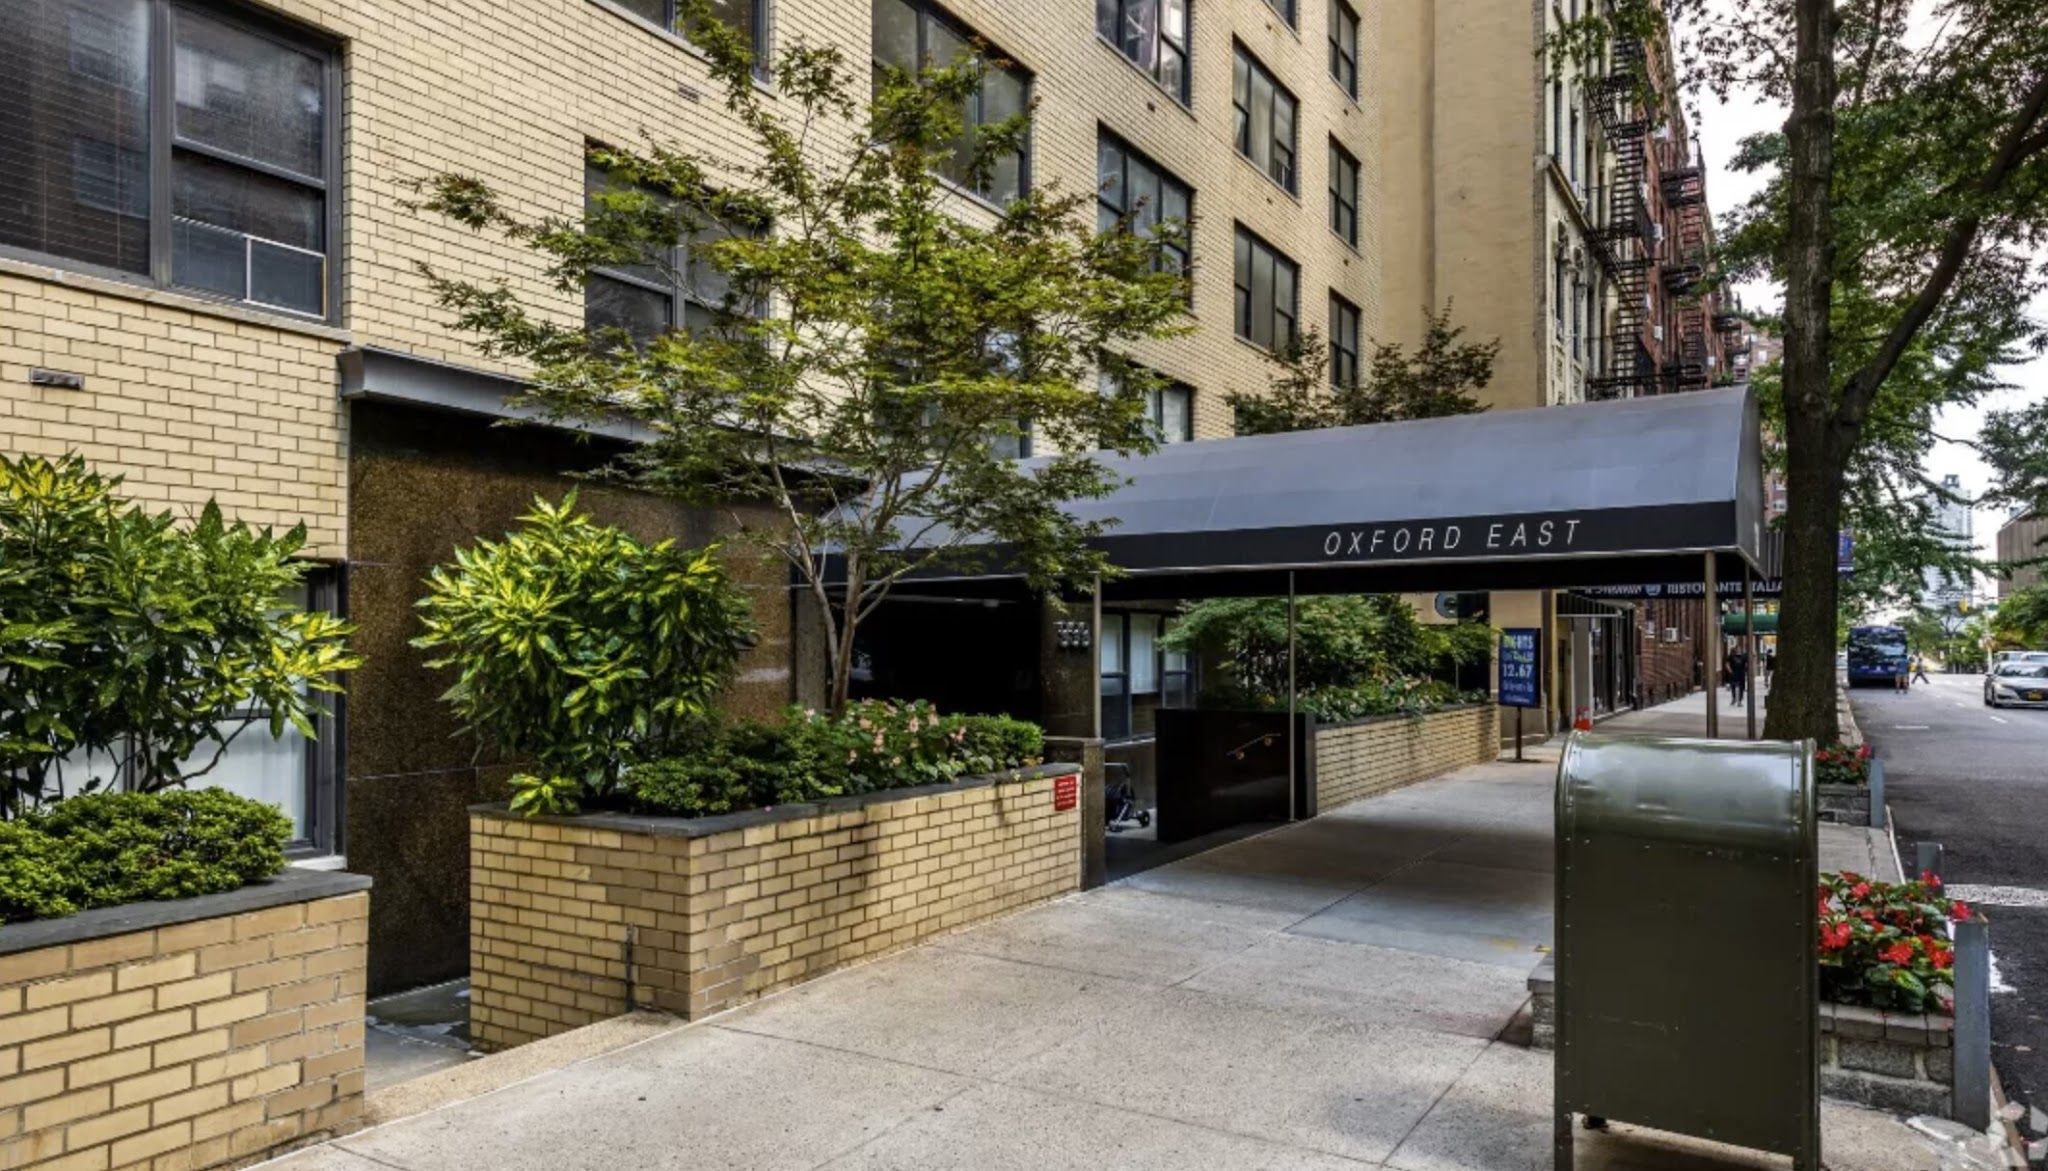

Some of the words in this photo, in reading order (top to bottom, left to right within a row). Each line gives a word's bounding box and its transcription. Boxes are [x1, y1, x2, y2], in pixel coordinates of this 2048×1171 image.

[1324, 526, 1461, 555] OXFORD
[1486, 520, 1581, 548] EAST
[1667, 582, 1743, 594] RISTONTE
[1503, 663, 1532, 679] 12.67
